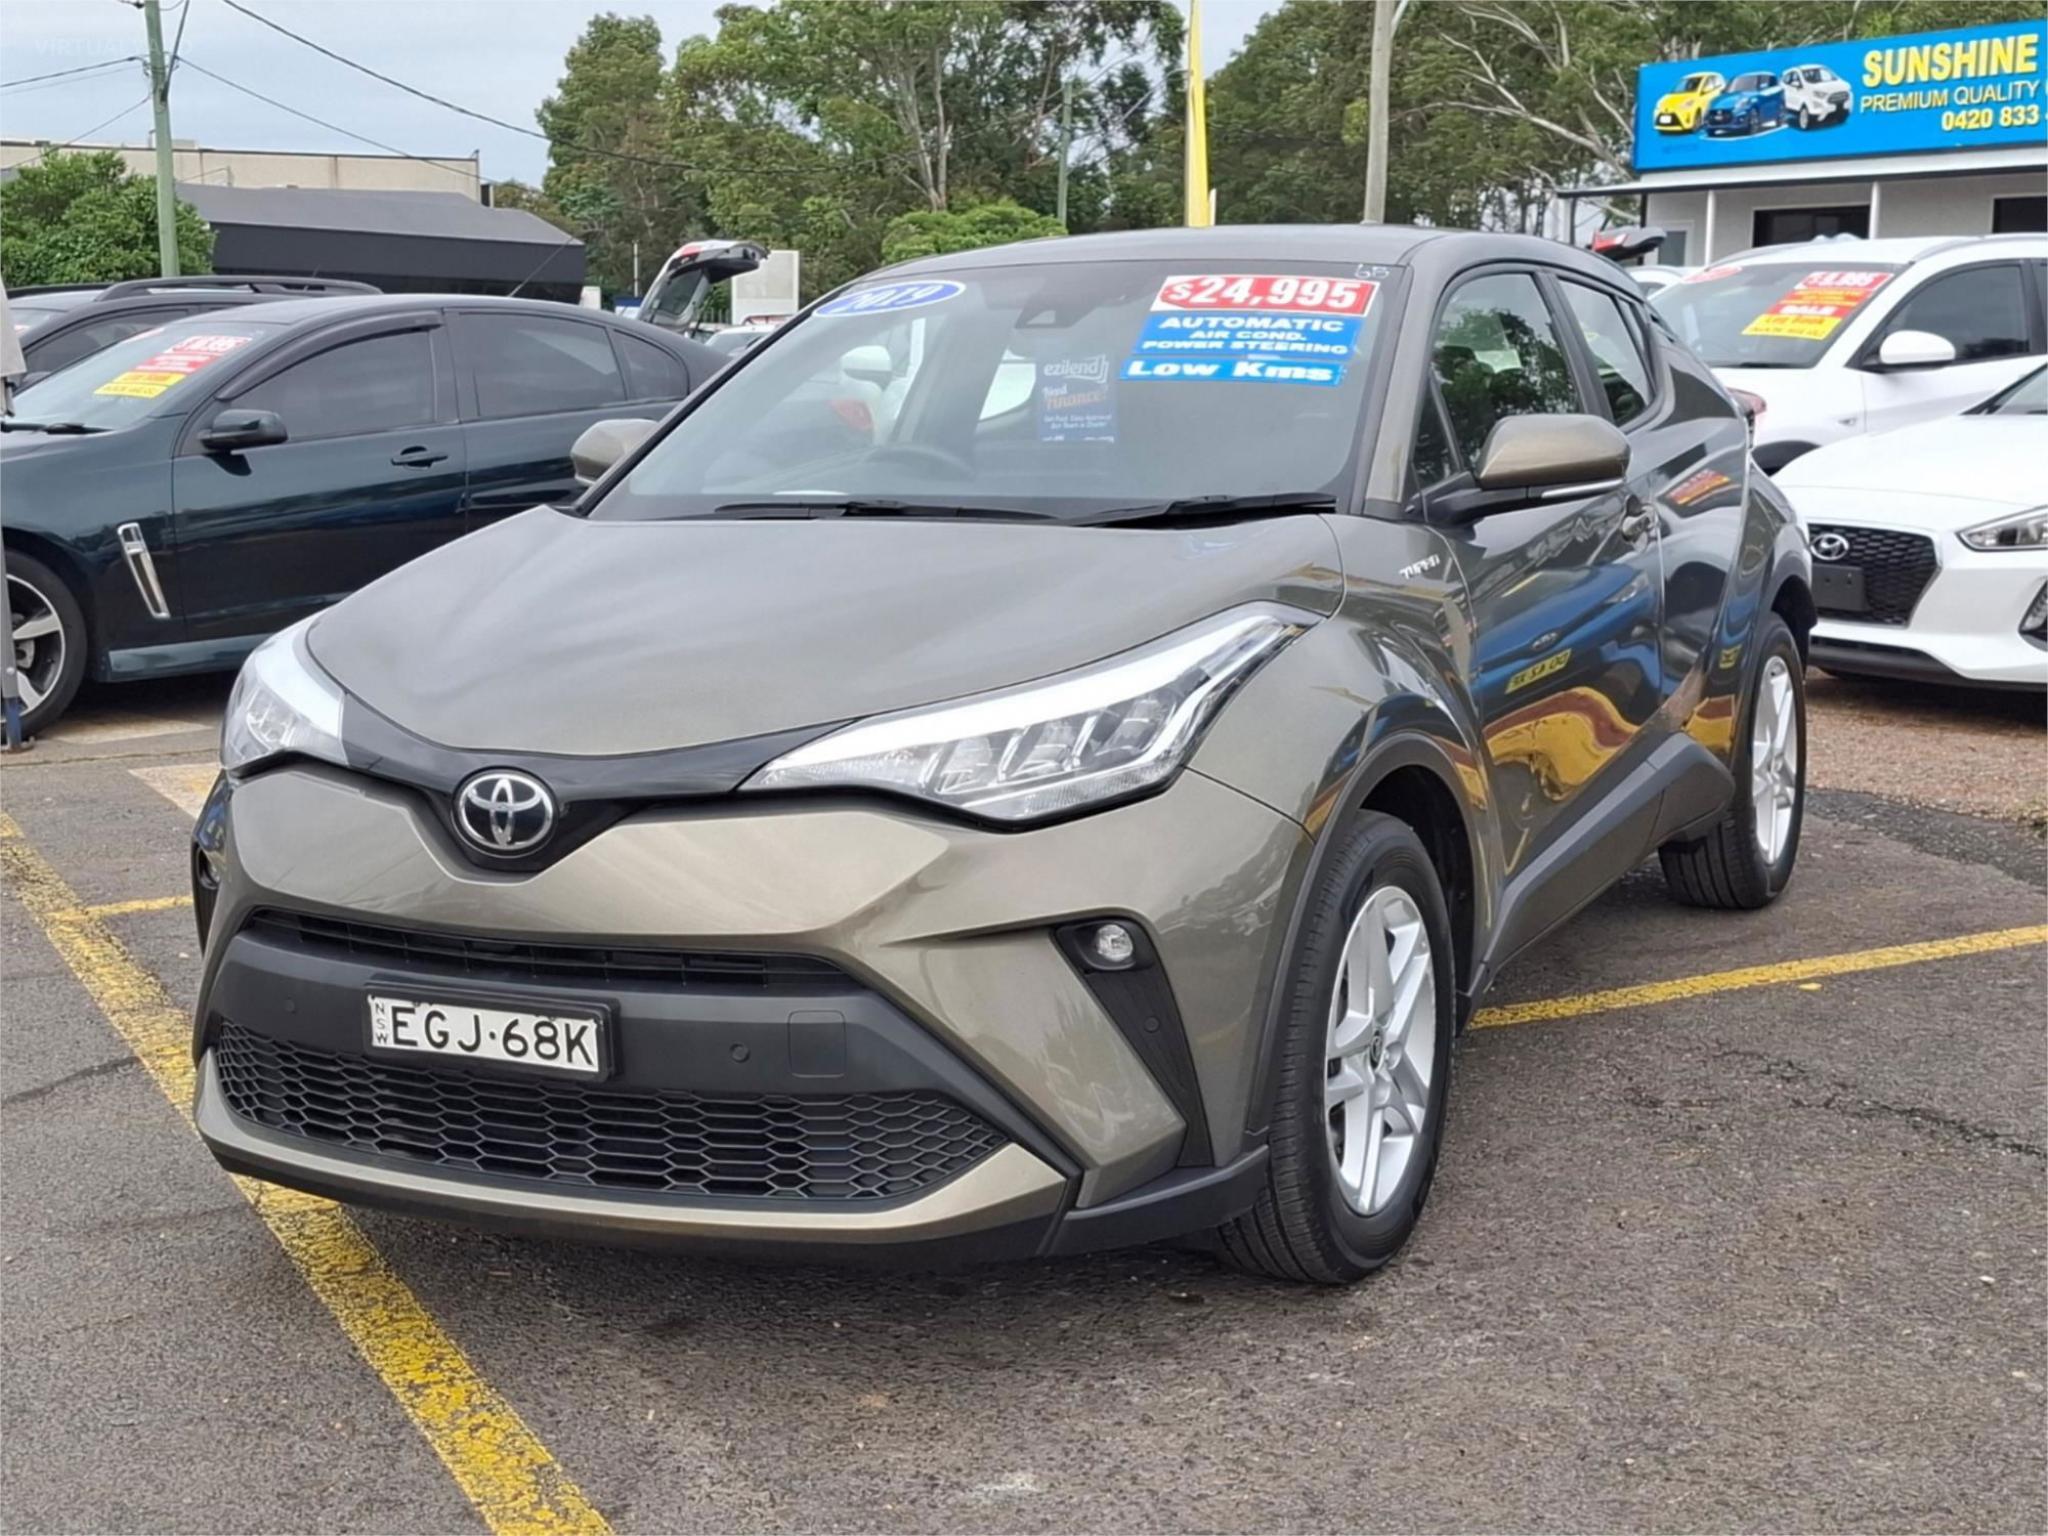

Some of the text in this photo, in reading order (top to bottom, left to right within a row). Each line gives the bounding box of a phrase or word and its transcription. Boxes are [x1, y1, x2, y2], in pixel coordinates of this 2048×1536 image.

[1862, 34, 2039, 88] SUNSHINE
[1860, 80, 2041, 113] PREMIUM QUALITY
[1941, 104, 2039, 131] 0420 833
[1168, 276, 1362, 308] $24,995
[1159, 316, 1345, 332] AUTOMATIC
[1142, 340, 1348, 354] POWER STEERING
[1189, 331, 1307, 341] AIR COND.
[1043, 358, 1098, 377] ezilend
